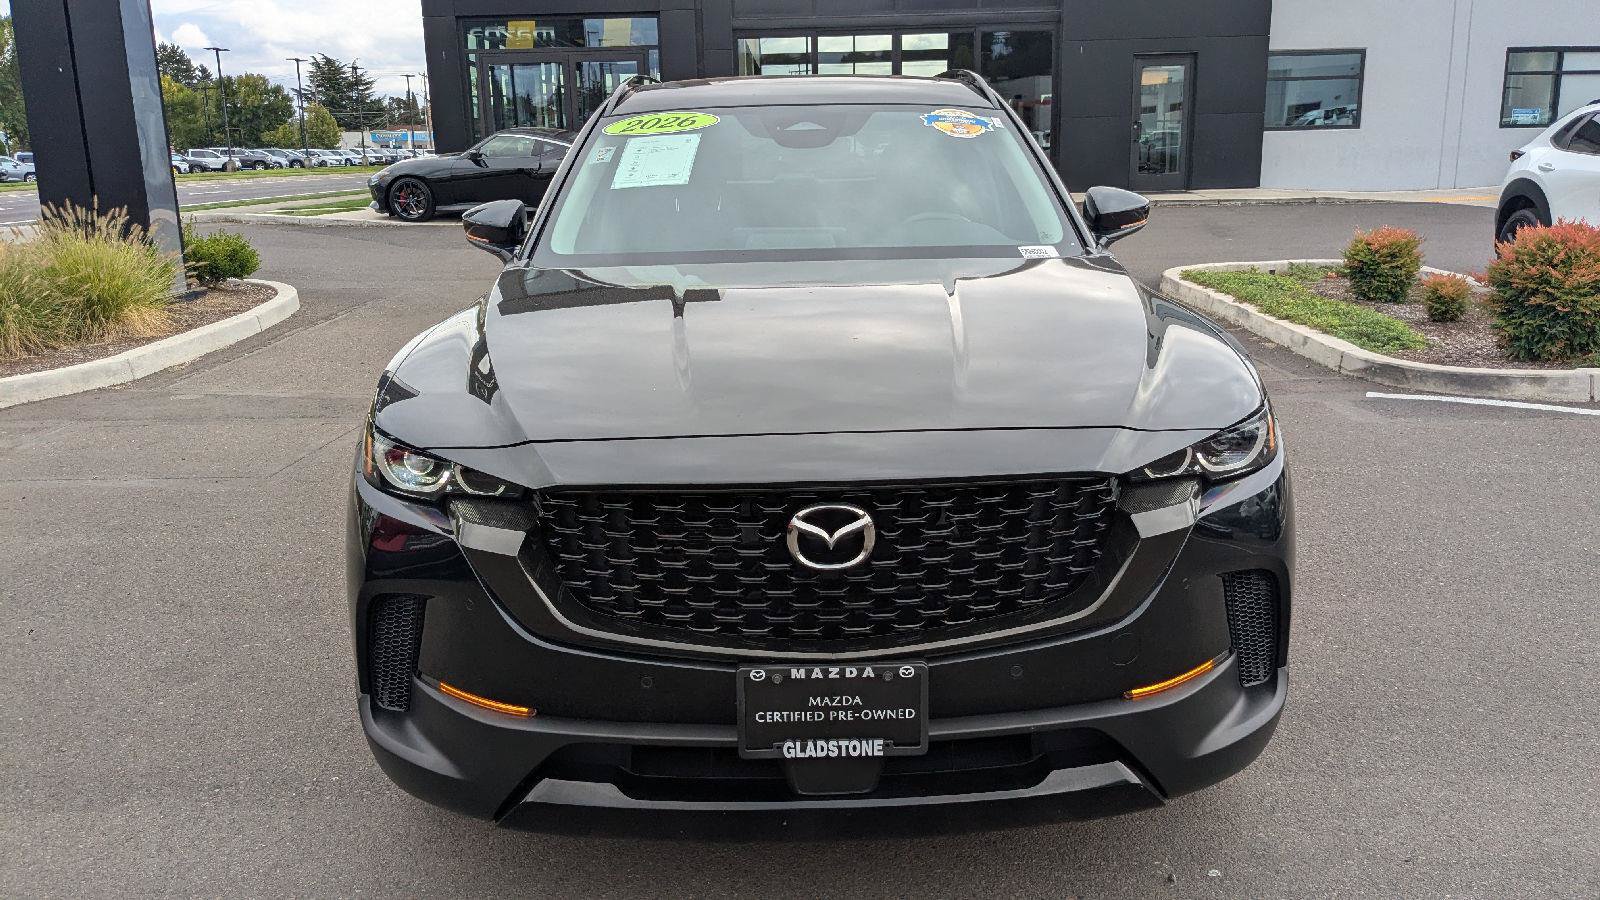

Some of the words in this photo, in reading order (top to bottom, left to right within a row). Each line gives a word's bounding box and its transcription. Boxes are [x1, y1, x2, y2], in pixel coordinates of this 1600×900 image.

[620, 115, 698, 134] 2026
[790, 667, 875, 680] MAZDA
[808, 695, 863, 707] MAZDA
[755, 711, 825, 723] CERTIFIED
[829, 708, 916, 721] PRE-OWNED
[782, 739, 884, 759] GLADSTONE
